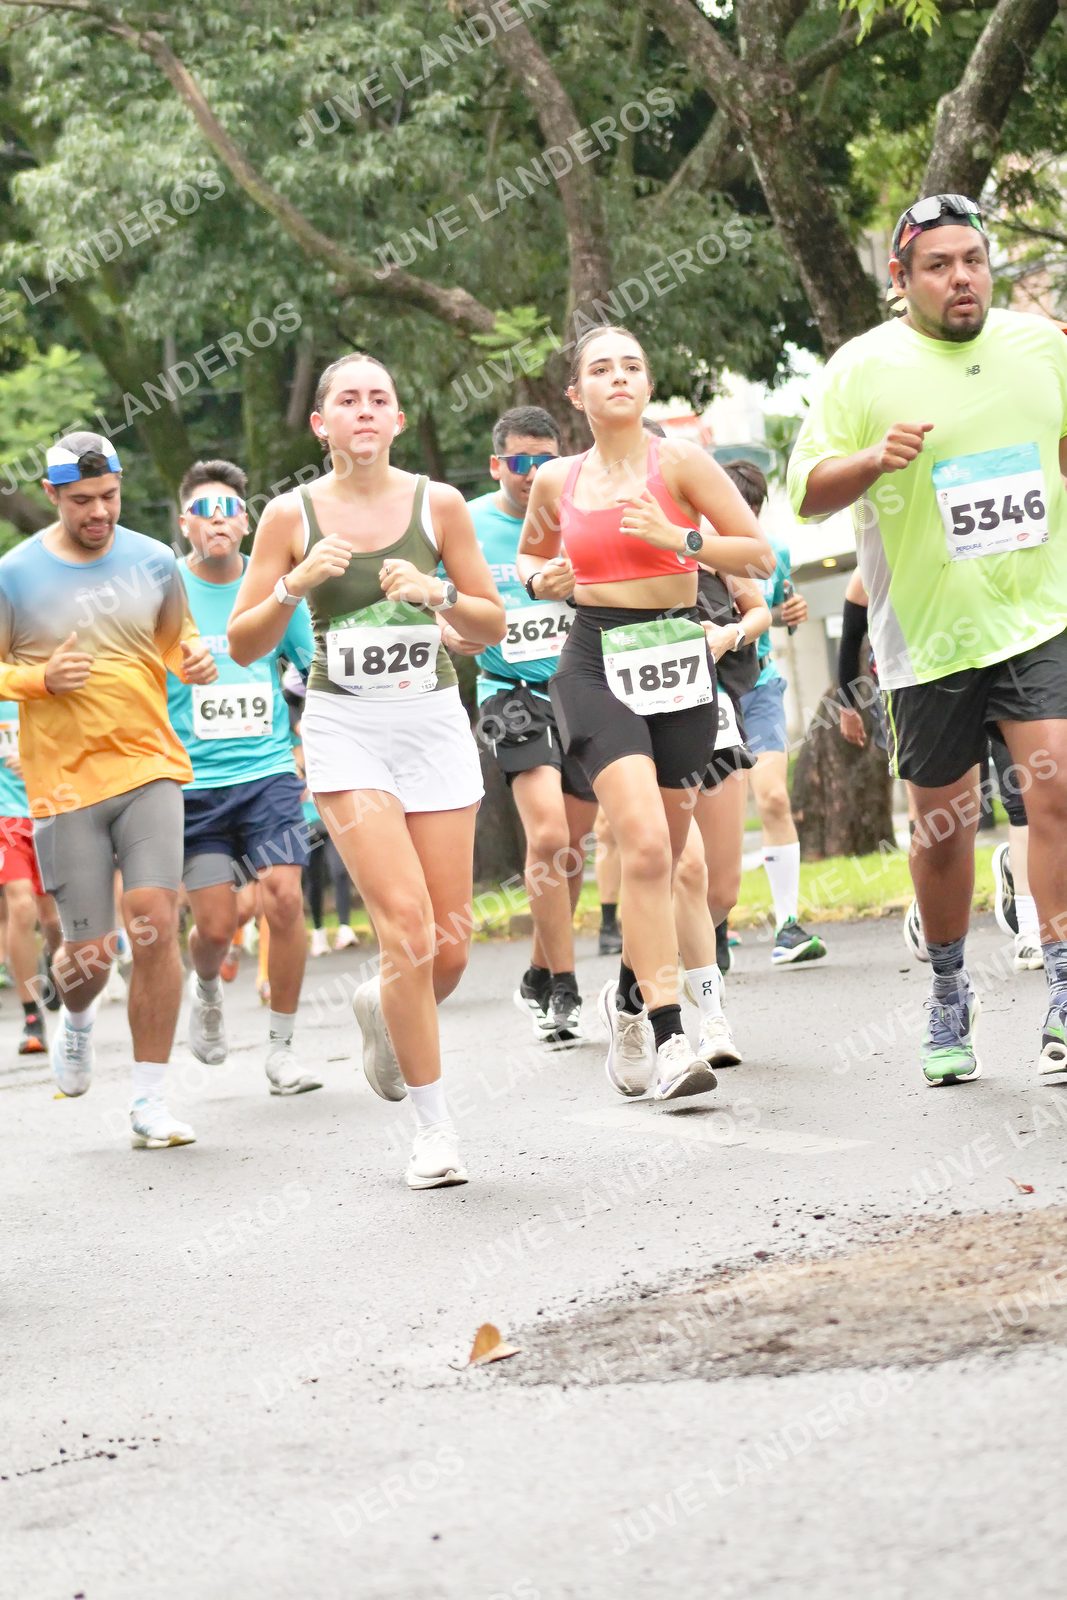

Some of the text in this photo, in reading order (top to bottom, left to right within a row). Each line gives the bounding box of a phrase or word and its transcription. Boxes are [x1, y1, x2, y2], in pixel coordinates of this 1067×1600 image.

[950, 489, 1046, 536] 5346
[506, 615, 572, 644] 3624
[339, 641, 431, 677] 1826
[616, 655, 700, 696] 1857
[200, 697, 267, 721] 6419
